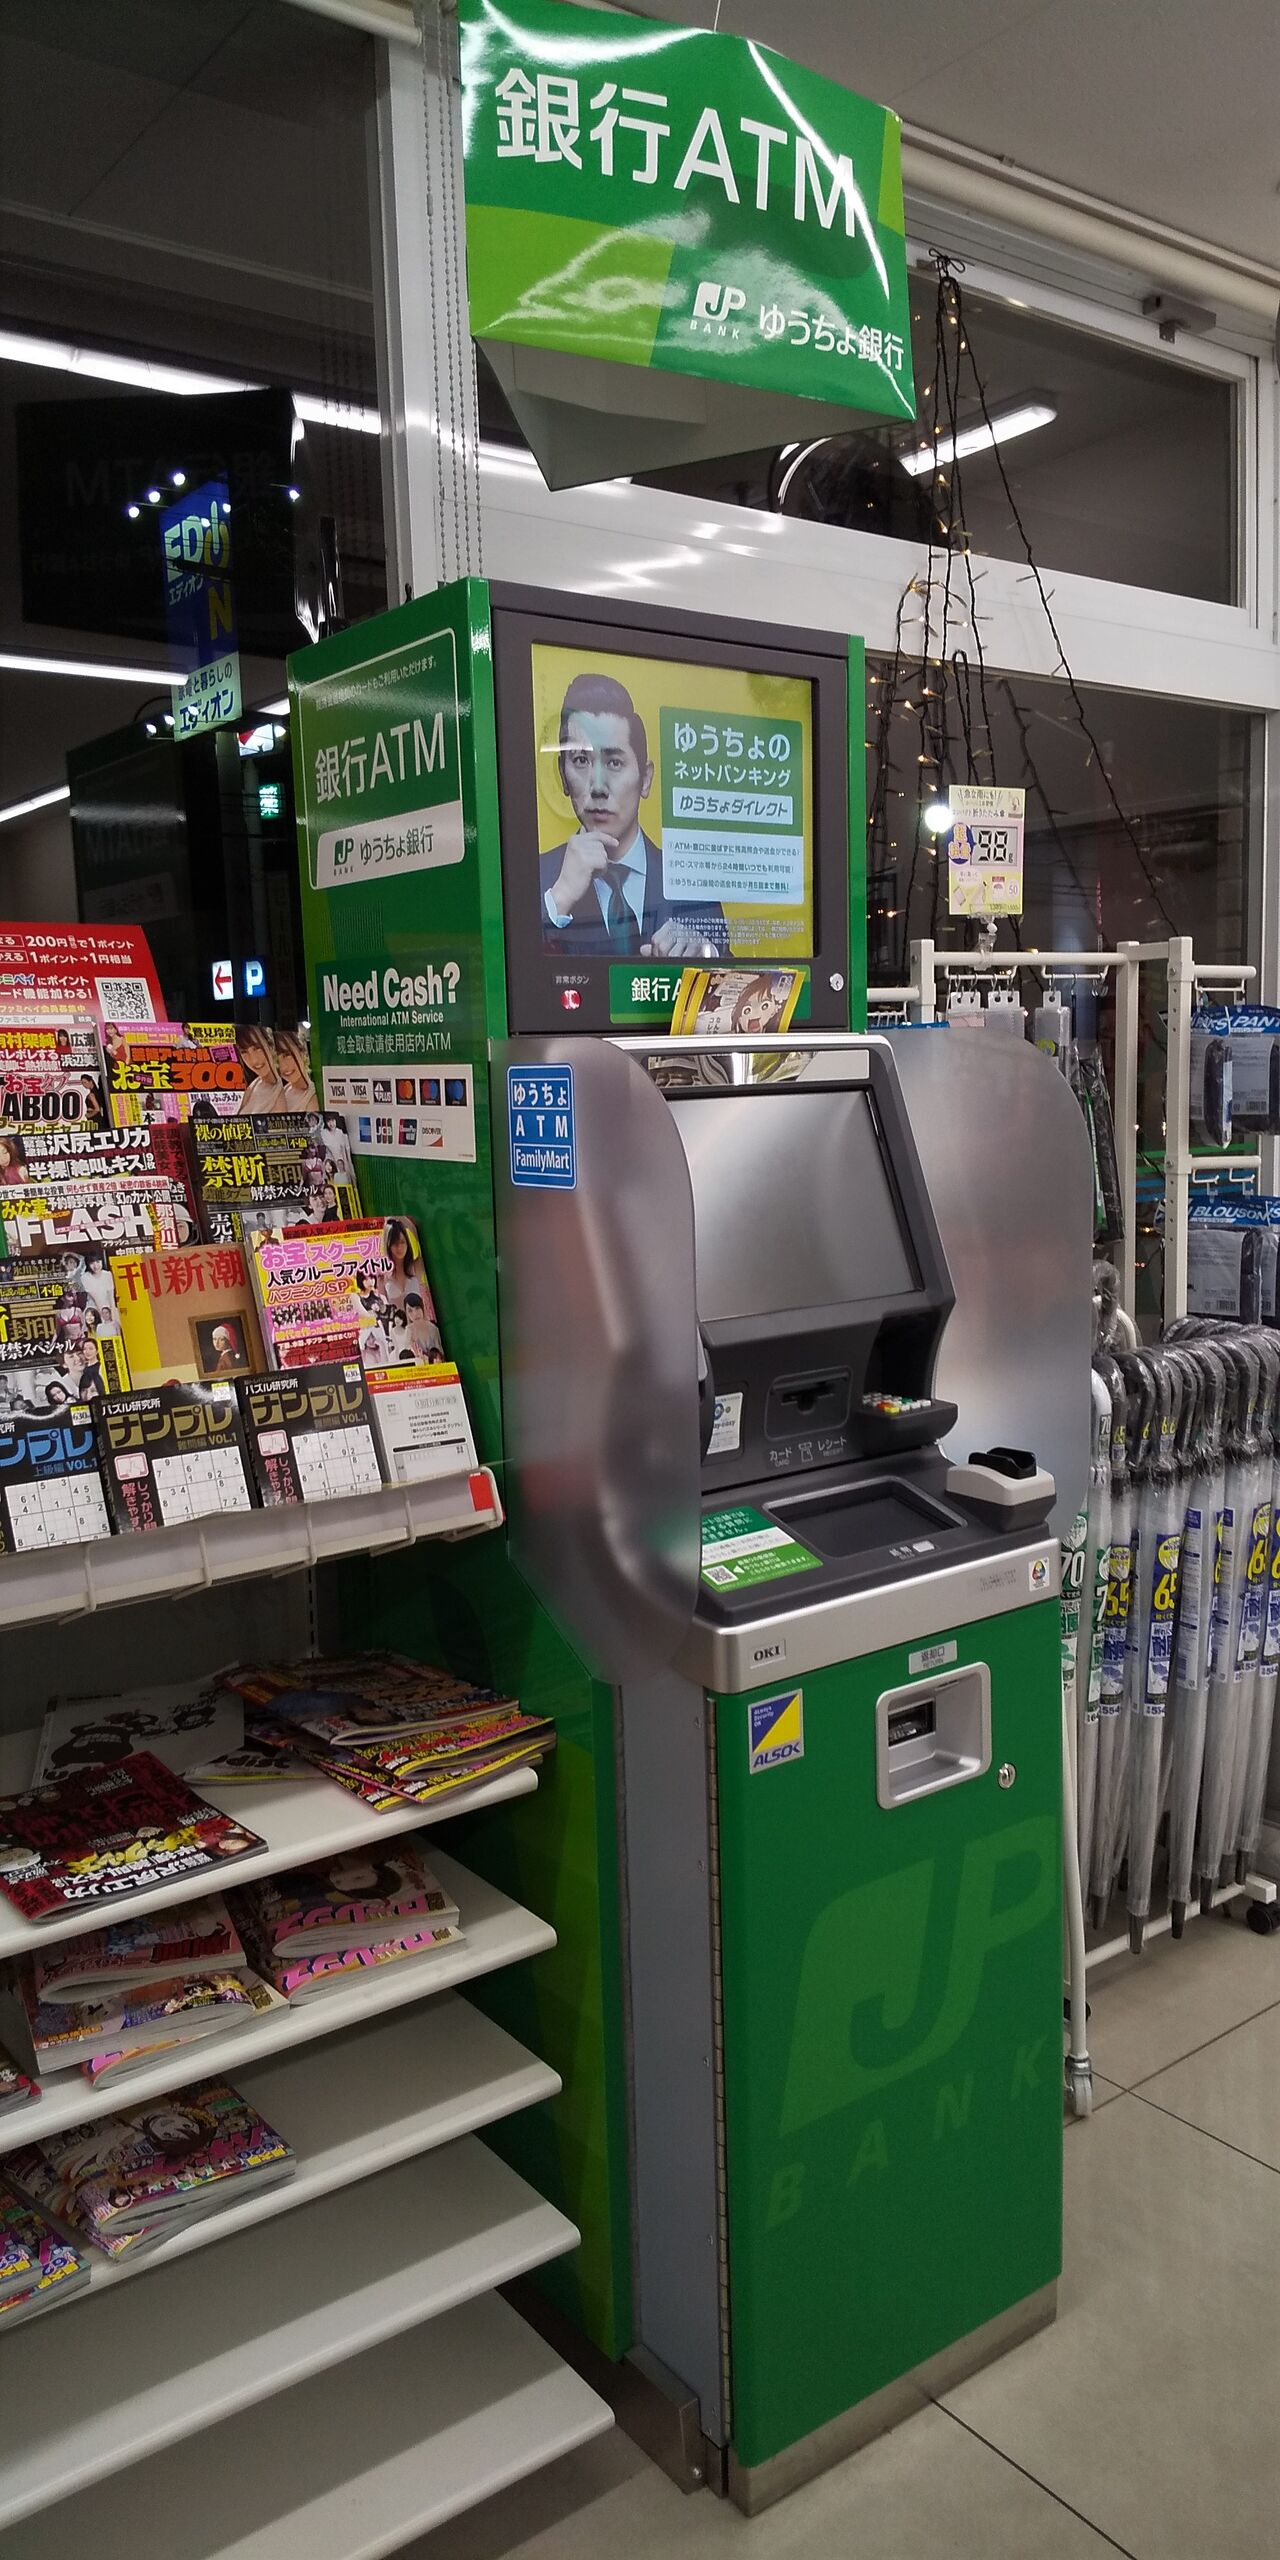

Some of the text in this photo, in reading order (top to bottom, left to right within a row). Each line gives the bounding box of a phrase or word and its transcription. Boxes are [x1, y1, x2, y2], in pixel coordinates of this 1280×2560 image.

[495, 67, 856, 238] 銀行ATM
[690, 319, 741, 340] BANK
[759, 304, 904, 371] ゆうちょ銀行
[673, 722, 791, 762] ゆうちょの
[314, 711, 446, 804] 銀行ATM
[674, 761, 792, 788] ネットバンキング
[679, 795, 788, 818] ゆうちょダイレクト
[360, 825, 433, 866] ゆうちょ銀行
[247, 961, 264, 996] P
[323, 961, 461, 1012] Need Cash?
[340, 1010, 444, 1028] International ATM Service
[337, 1032, 451, 1054] 现金取款请使用店内ATM
[331, 1085, 346, 1097] VISA
[353, 1084, 367, 1096] VISA
[514, 1083, 567, 1106] ゆうちょ
[195, 1123, 253, 1142] 裸の値段
[516, 1115, 568, 1138] ATM
[47, 1127, 150, 1155] 沢尻エリカ
[201, 1154, 265, 1188] 禁断
[516, 1149, 569, 1172] FamilyMart
[16, 1204, 154, 1248] FLASH
[267, 1258, 393, 1287] 人気グループアイドル
[41, 1285, 64, 1297] 不倫
[245, 1380, 298, 1395] パズル研究所
[102, 1398, 161, 1416] パズル研究所
[250, 1384, 363, 1426] ナンプレ
[106, 1405, 233, 1449] ナンプレ
[342, 1411, 368, 1424] VOL.1
[208, 1434, 237, 1447] VOL.1
[818, 1437, 846, 1451] レシート
[66, 1458, 98, 1471] VOL.1
[770, 1447, 792, 1461] カード
[753, 1645, 781, 1662] OKI
[753, 1742, 801, 1768] ALSOK
